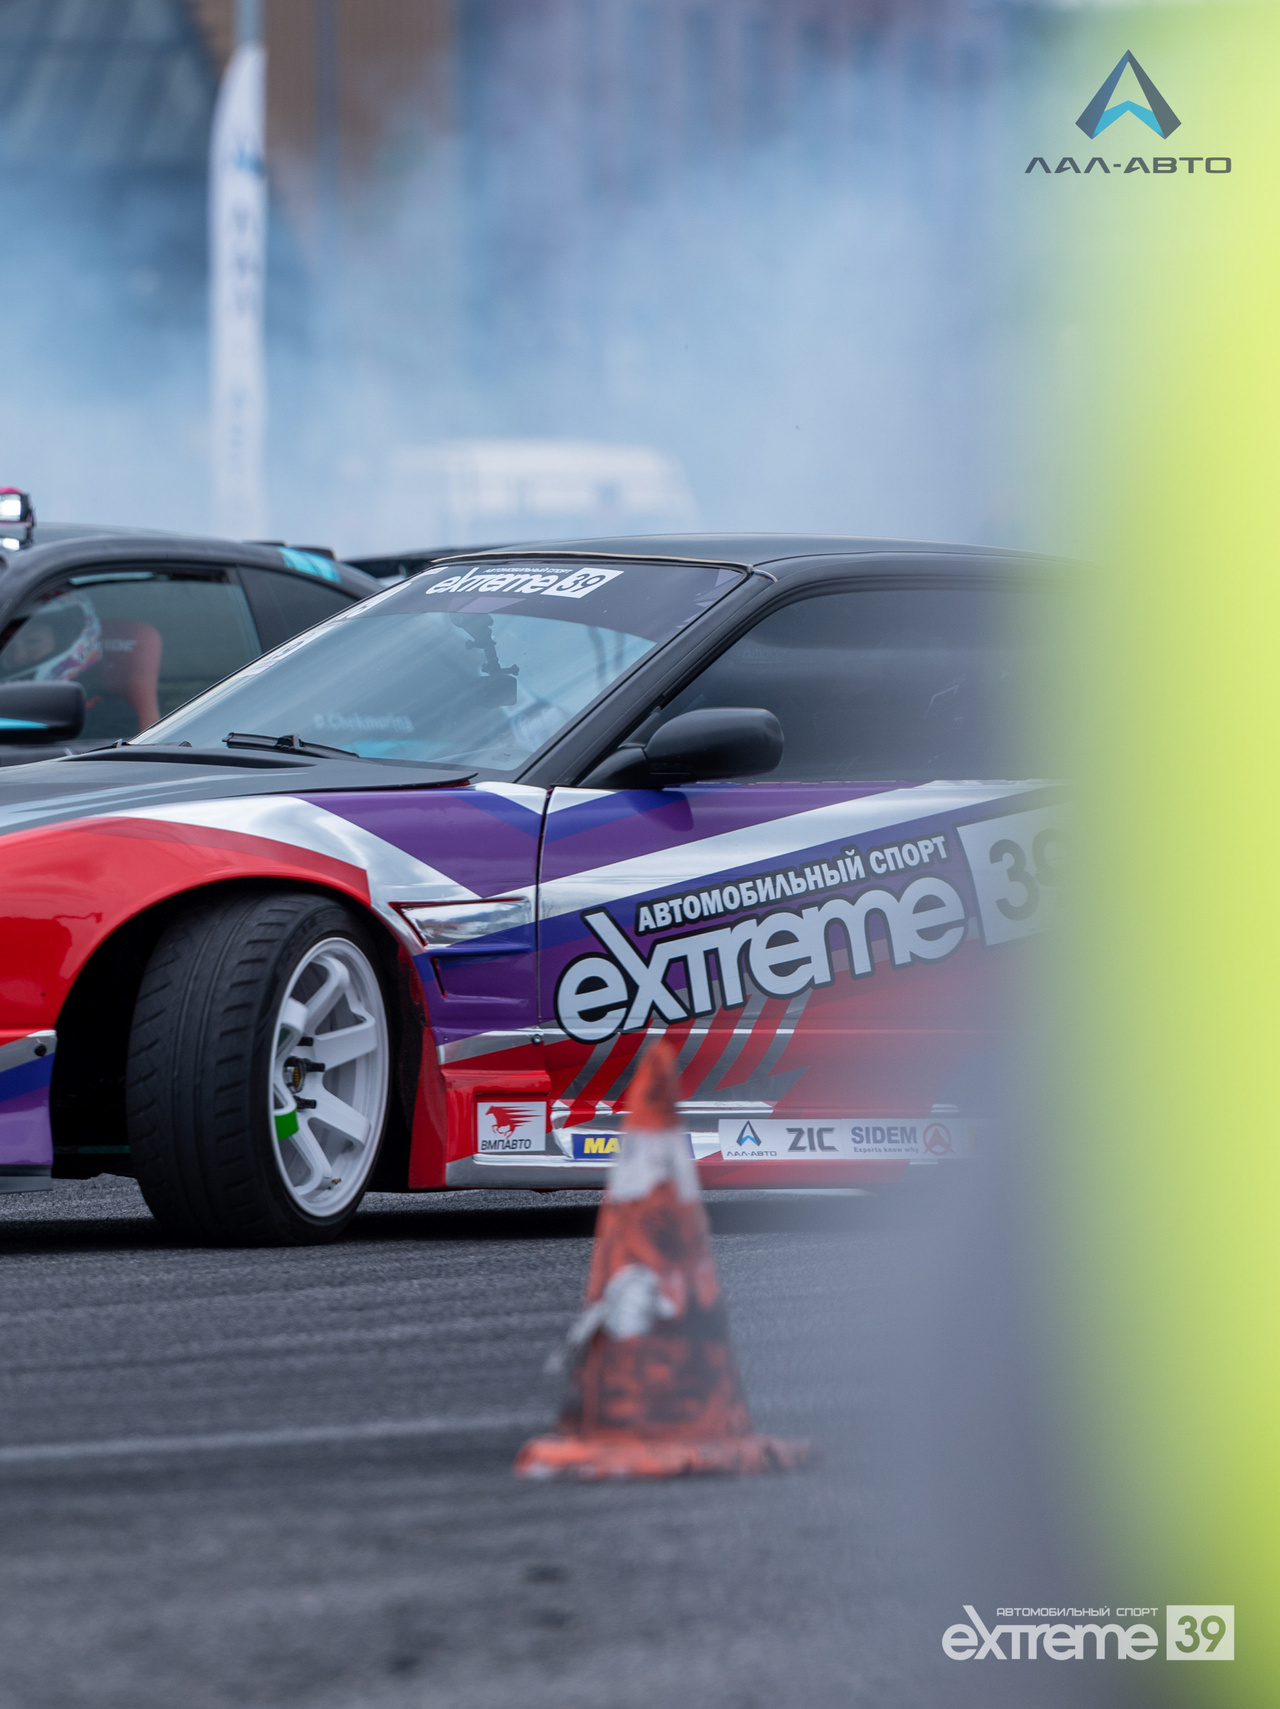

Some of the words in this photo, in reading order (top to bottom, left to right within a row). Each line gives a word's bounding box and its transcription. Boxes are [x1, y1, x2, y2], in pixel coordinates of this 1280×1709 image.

[637, 849, 866, 933] АВТОМОБИЛЬНЫЙ
[870, 835, 948, 876] СПОРТ
[481, 1138, 532, 1151] ВМПАВТО
[785, 1127, 839, 1152] ZIC
[851, 1126, 918, 1145] SIDEM
[853, 1146, 882, 1154] Experts
